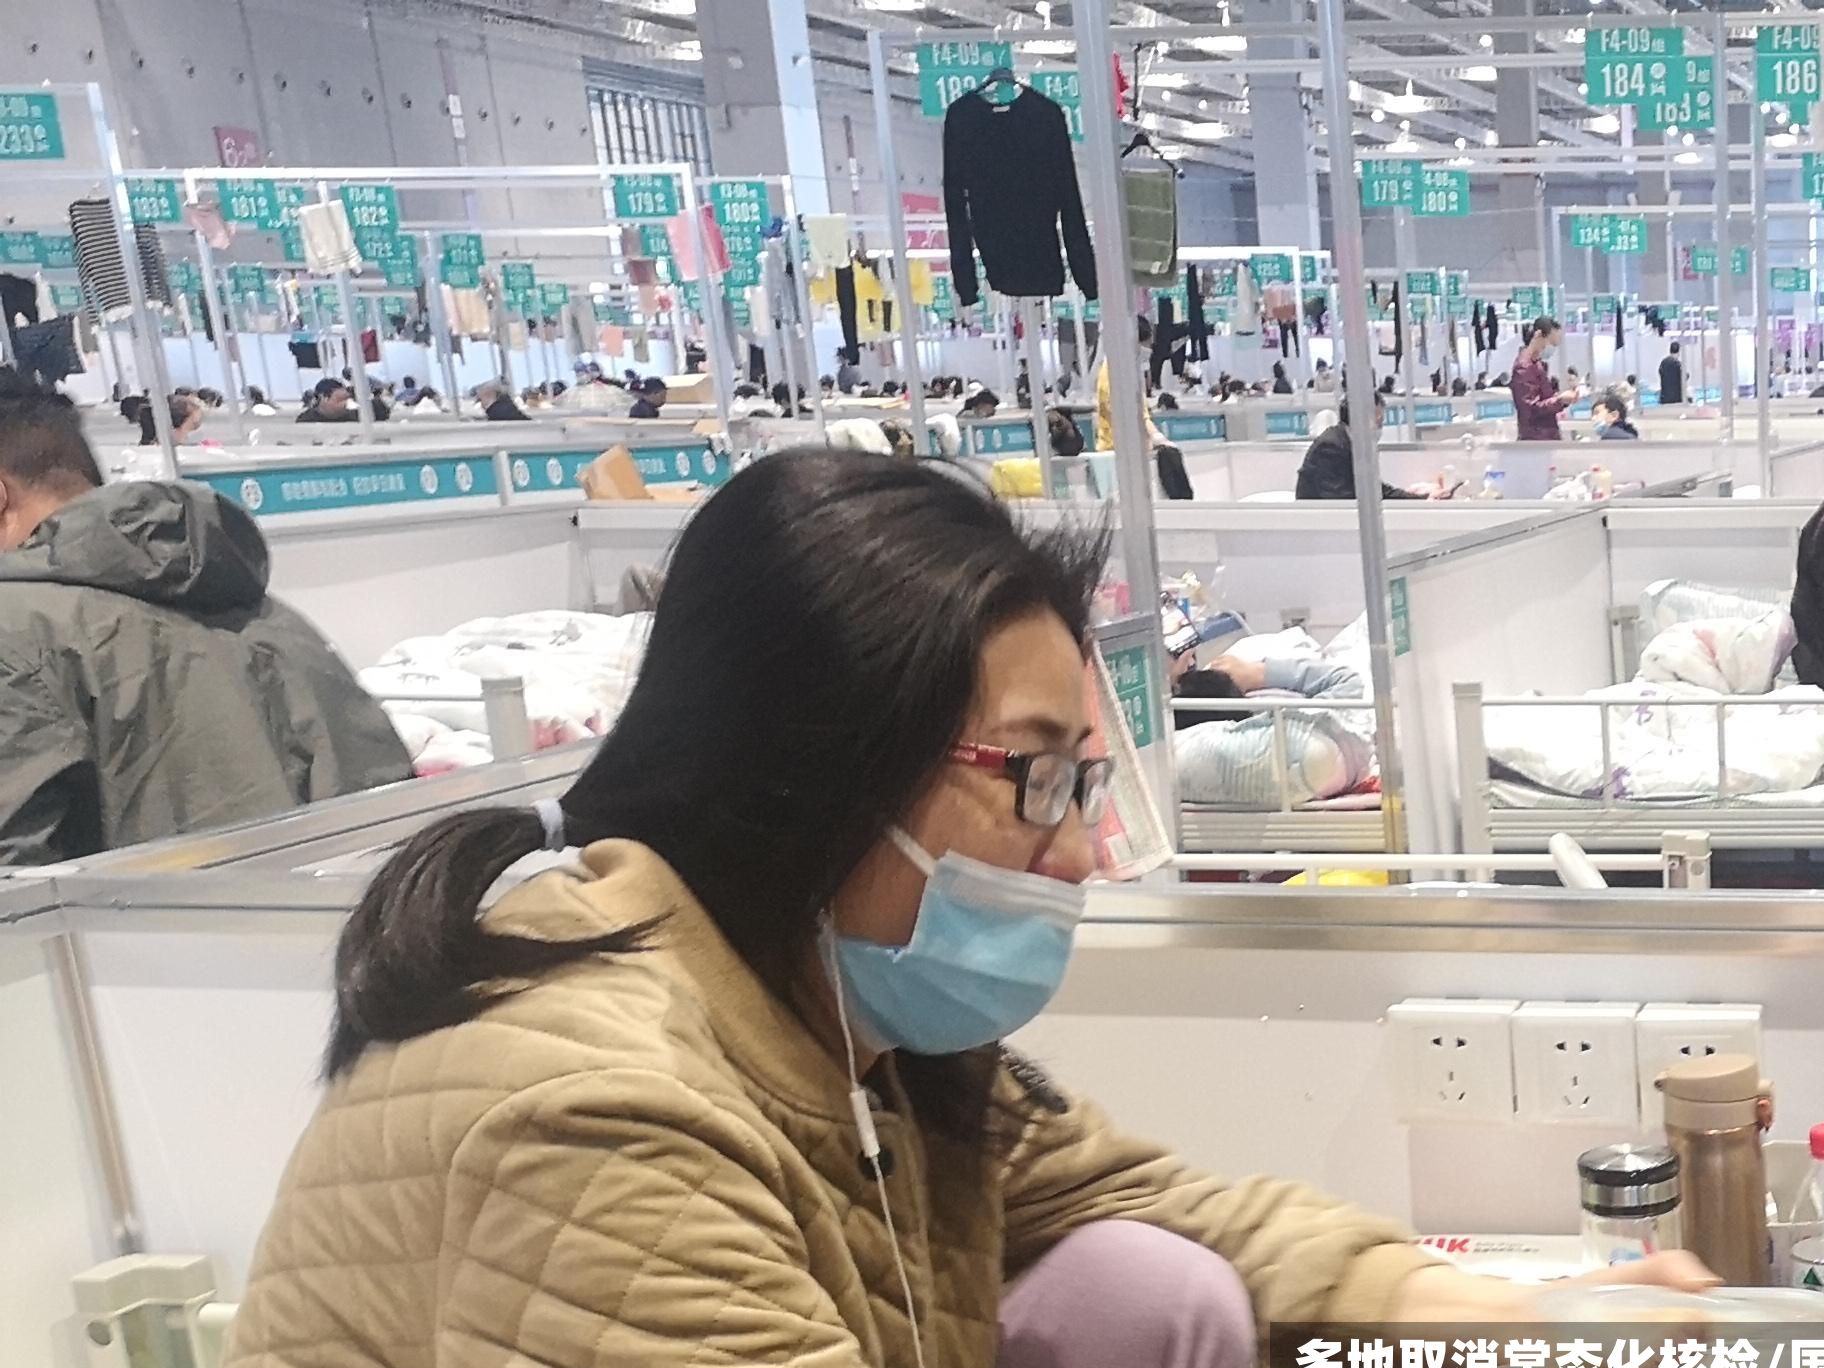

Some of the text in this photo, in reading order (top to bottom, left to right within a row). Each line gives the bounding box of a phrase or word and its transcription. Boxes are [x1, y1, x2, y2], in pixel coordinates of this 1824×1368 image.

[1601, 28, 1651, 52] F4-09
[1602, 62, 1645, 98] 184
[1773, 59, 1817, 94] 186
